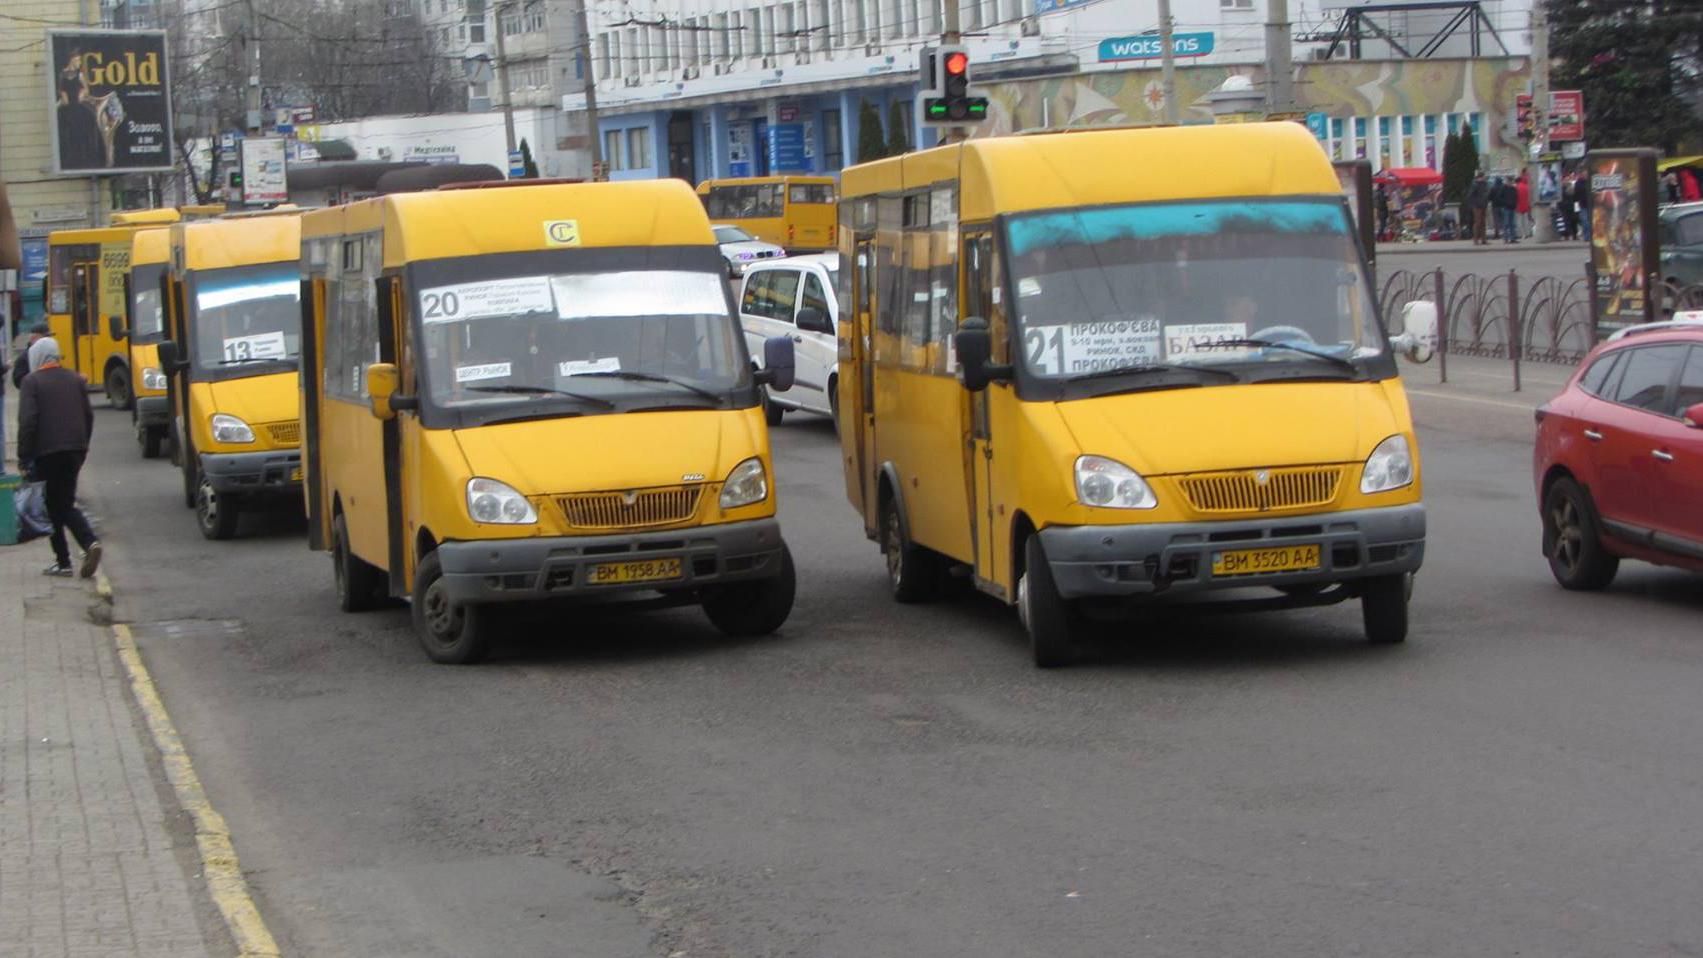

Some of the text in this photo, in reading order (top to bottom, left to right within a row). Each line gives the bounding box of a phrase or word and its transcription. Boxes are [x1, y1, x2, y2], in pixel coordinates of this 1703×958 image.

[1111, 37, 1199, 56] watsns
[82, 52, 160, 86] Gold
[423, 291, 459, 318] 20
[225, 341, 251, 361] 13
[1025, 327, 1065, 375] 21
[597, 565, 618, 580] BM
[624, 562, 653, 579] 1958
[1223, 547, 1316, 571] BM 3520 AA
